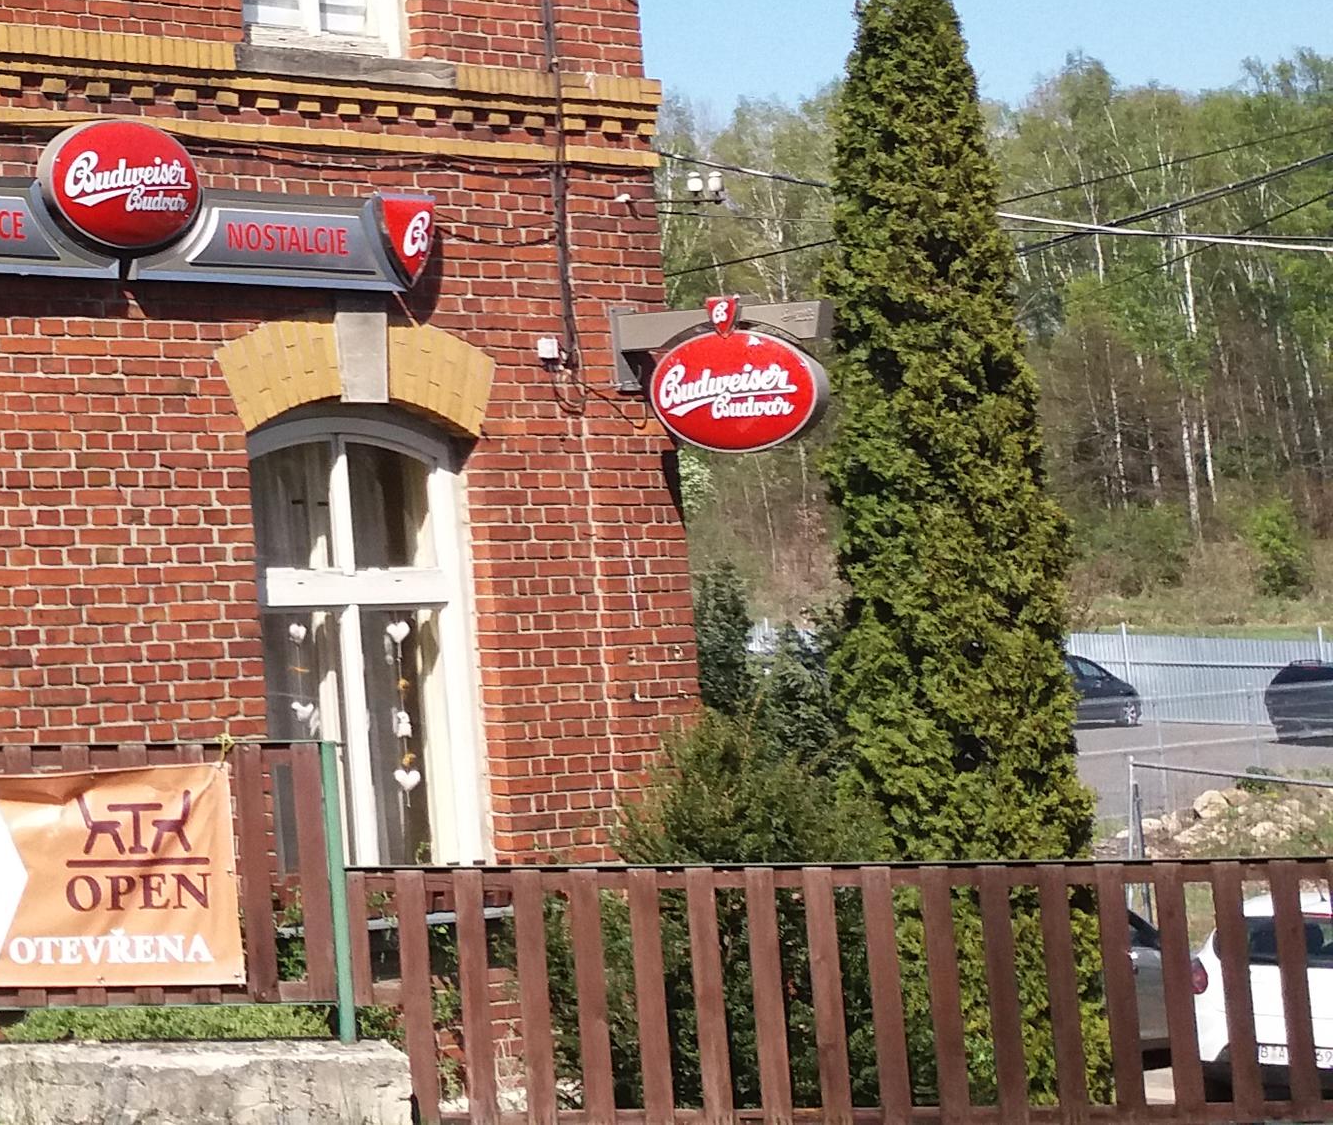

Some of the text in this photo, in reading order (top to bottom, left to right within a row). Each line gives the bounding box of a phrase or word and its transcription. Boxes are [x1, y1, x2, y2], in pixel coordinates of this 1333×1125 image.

[65, 150, 191, 202] Budweiser
[126, 188, 189, 212] Budvar
[227, 221, 350, 257] NOSTALGIE
[659, 362, 798, 412] Budweiser
[711, 392, 794, 420] Budvar
[65, 872, 212, 912] OPEN
[8, 928, 215, 965] OTEVŘENA
